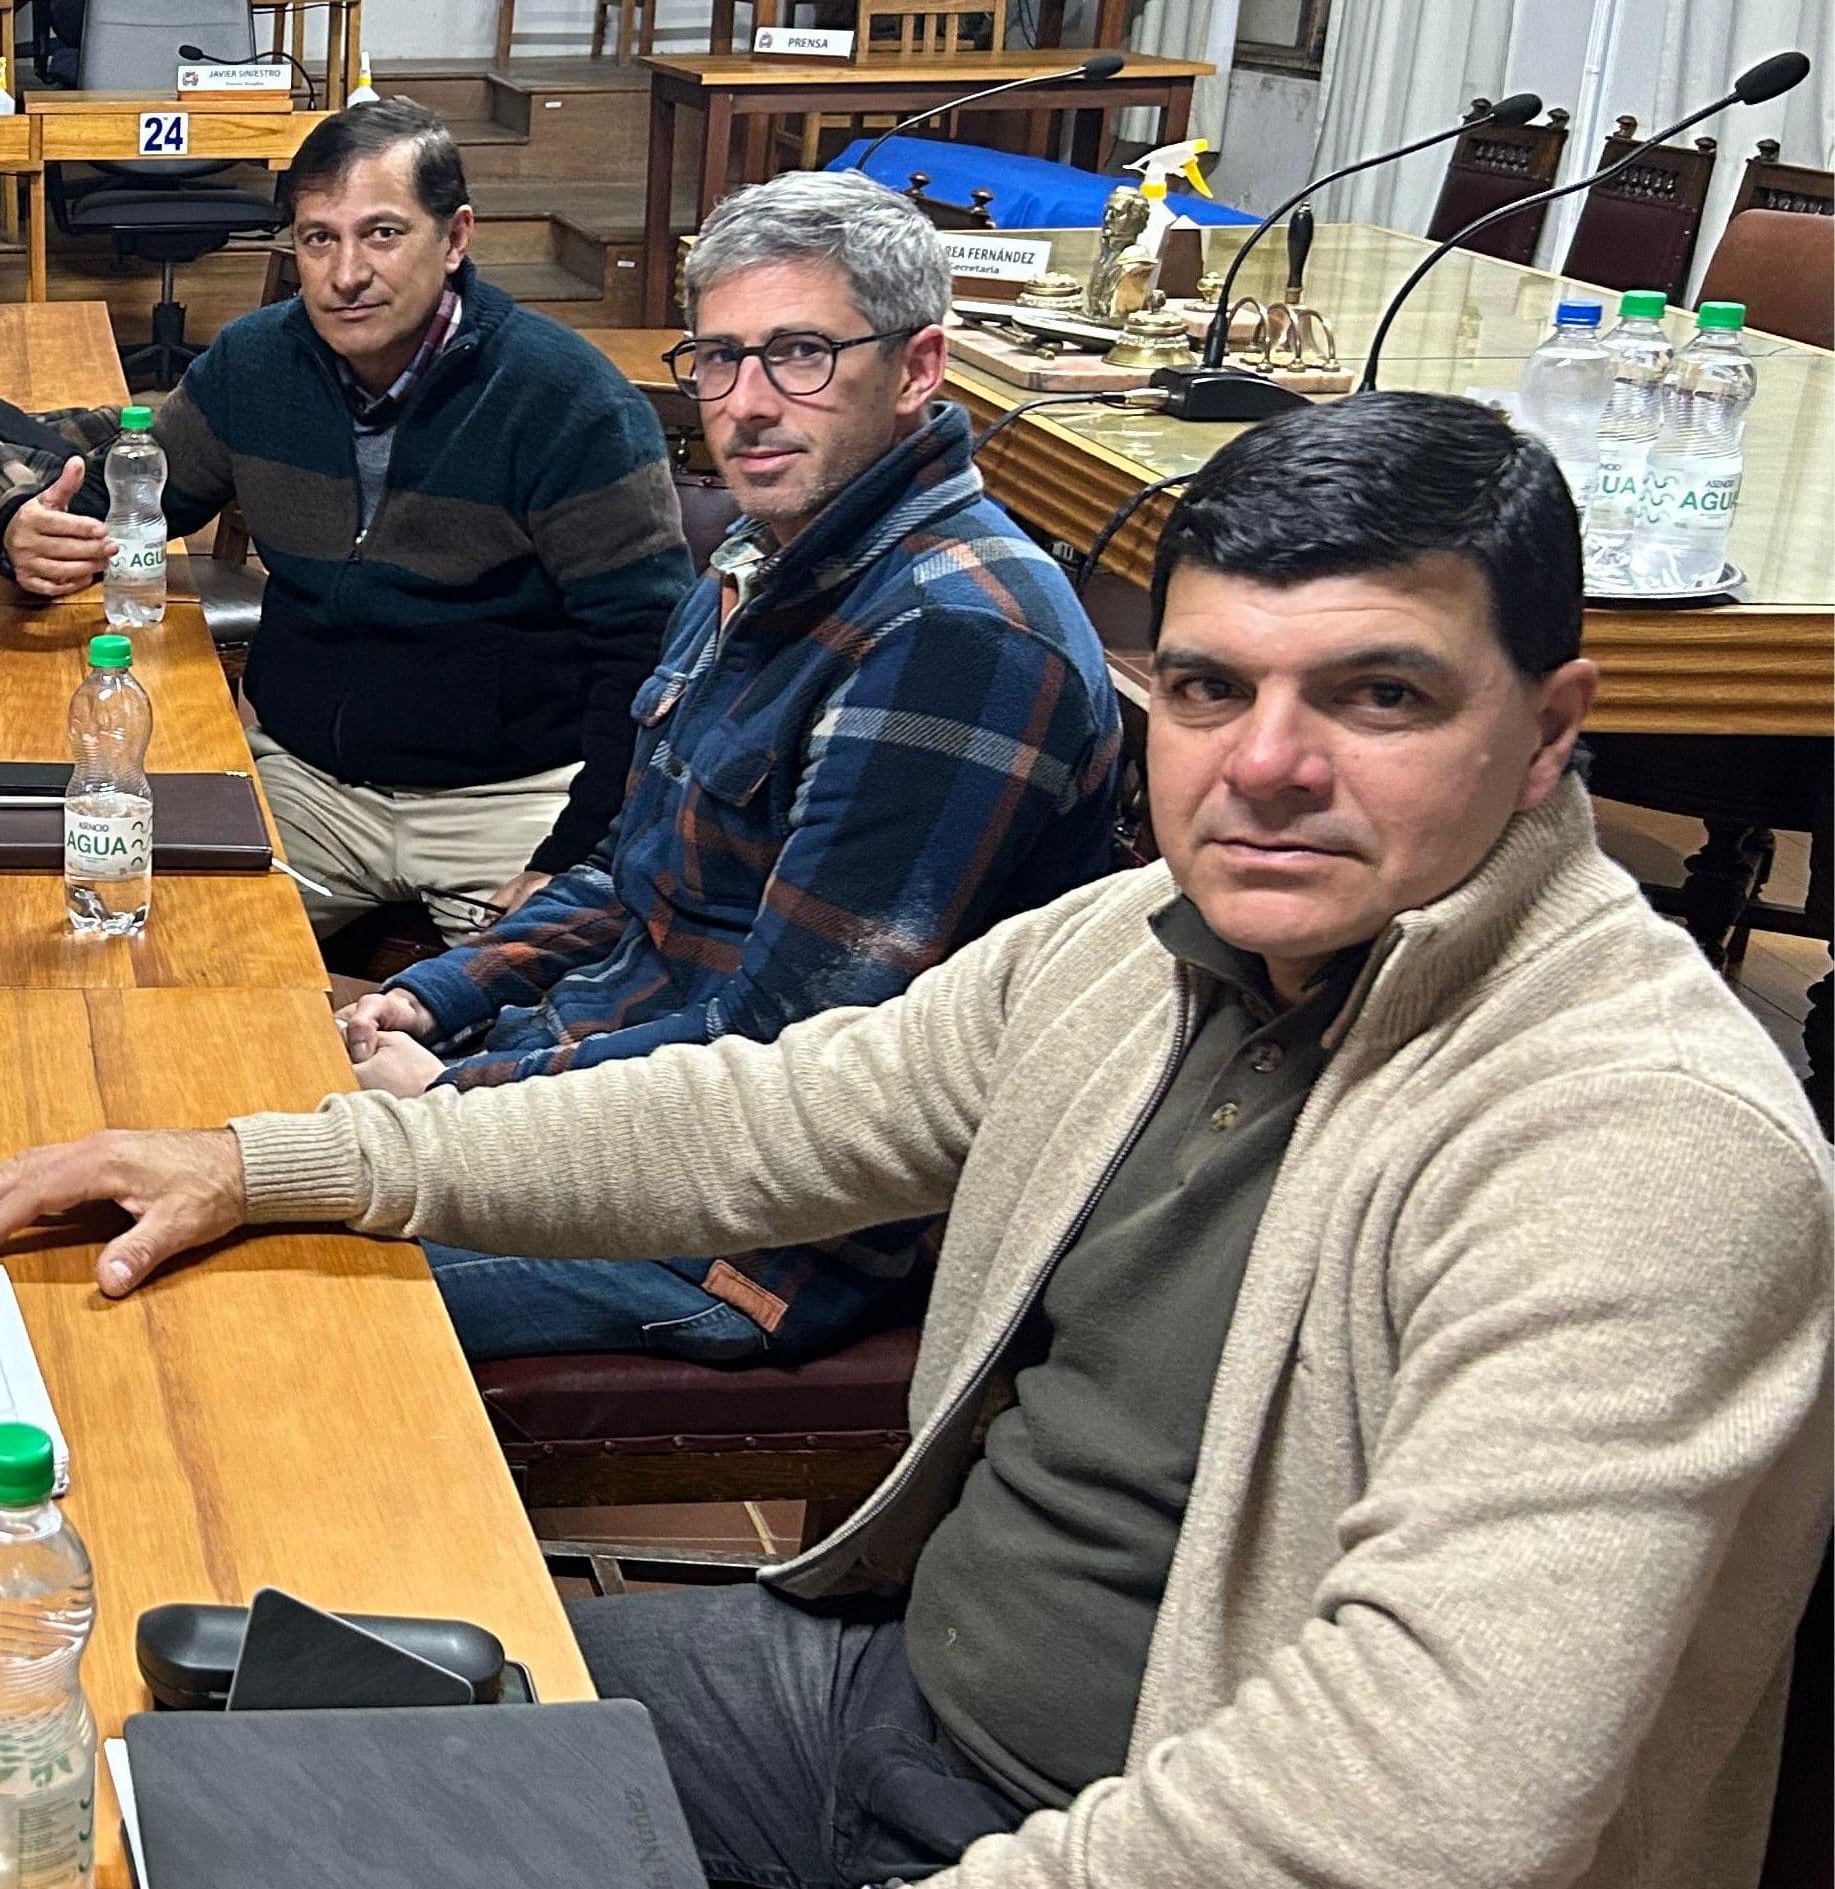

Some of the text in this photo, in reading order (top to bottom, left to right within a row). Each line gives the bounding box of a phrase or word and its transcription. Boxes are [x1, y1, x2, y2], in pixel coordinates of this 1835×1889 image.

[788, 37, 828, 48] PRENSA
[208, 70, 237, 78] JAVIER
[144, 116, 183, 151] 24
[945, 245, 1035, 265] REA FERNÁNDEZ
[1679, 490, 1738, 512] AGU
[130, 551, 165, 568] AGU
[67, 829, 128, 856] AGUA
